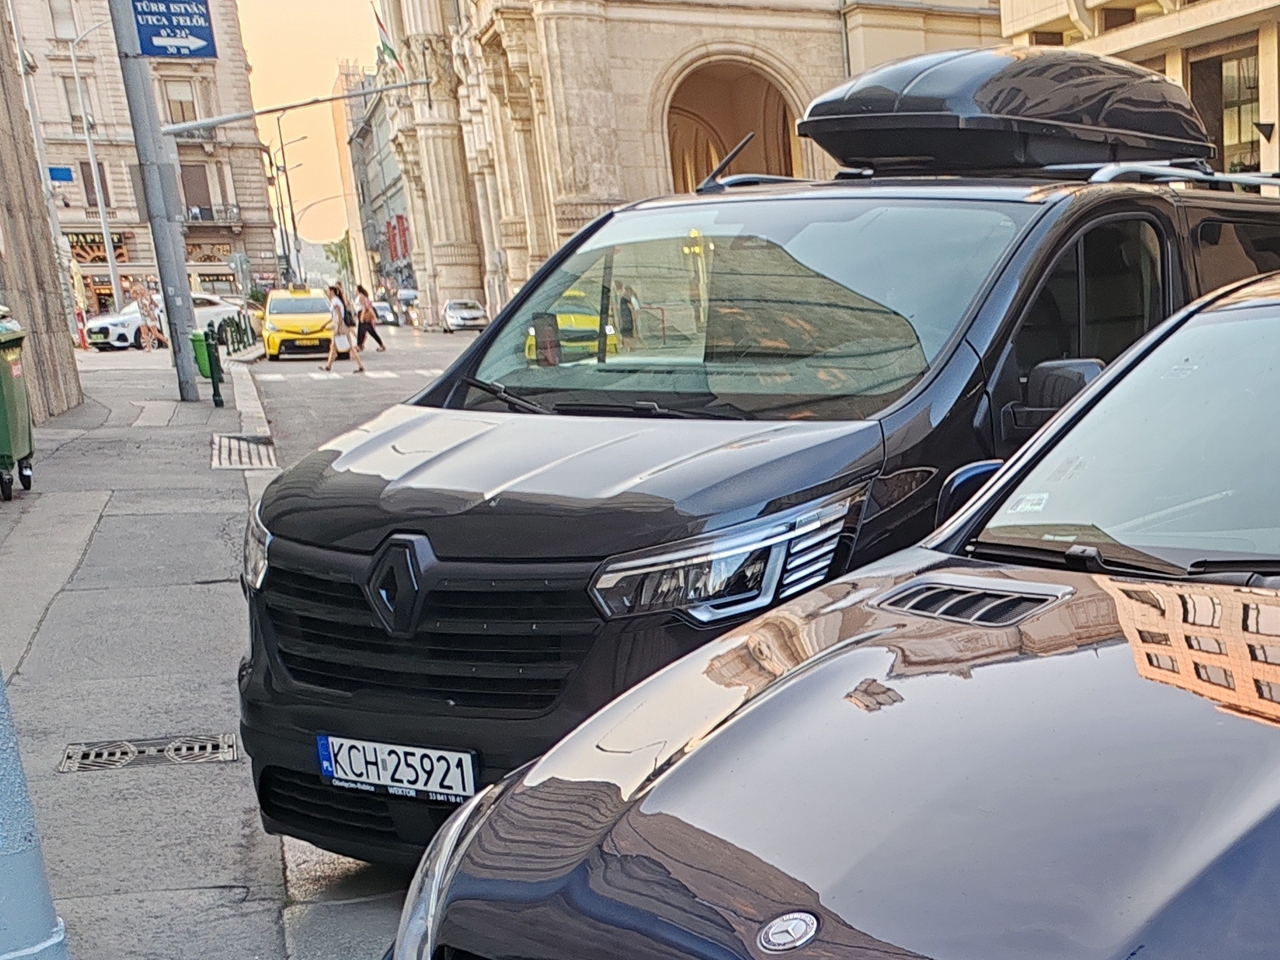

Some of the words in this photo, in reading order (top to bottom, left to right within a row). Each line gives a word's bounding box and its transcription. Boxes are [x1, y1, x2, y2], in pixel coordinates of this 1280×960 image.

[135, 1, 167, 13] TÜRR
[169, 2, 207, 15] ISTVÁN
[137, 15, 169, 26] UTCA
[166, 46, 178, 54] 30
[322, 760, 333, 772] PL
[331, 741, 382, 782] KCH
[387, 749, 467, 793] 25921
[387, 786, 417, 798] WEKTOR
